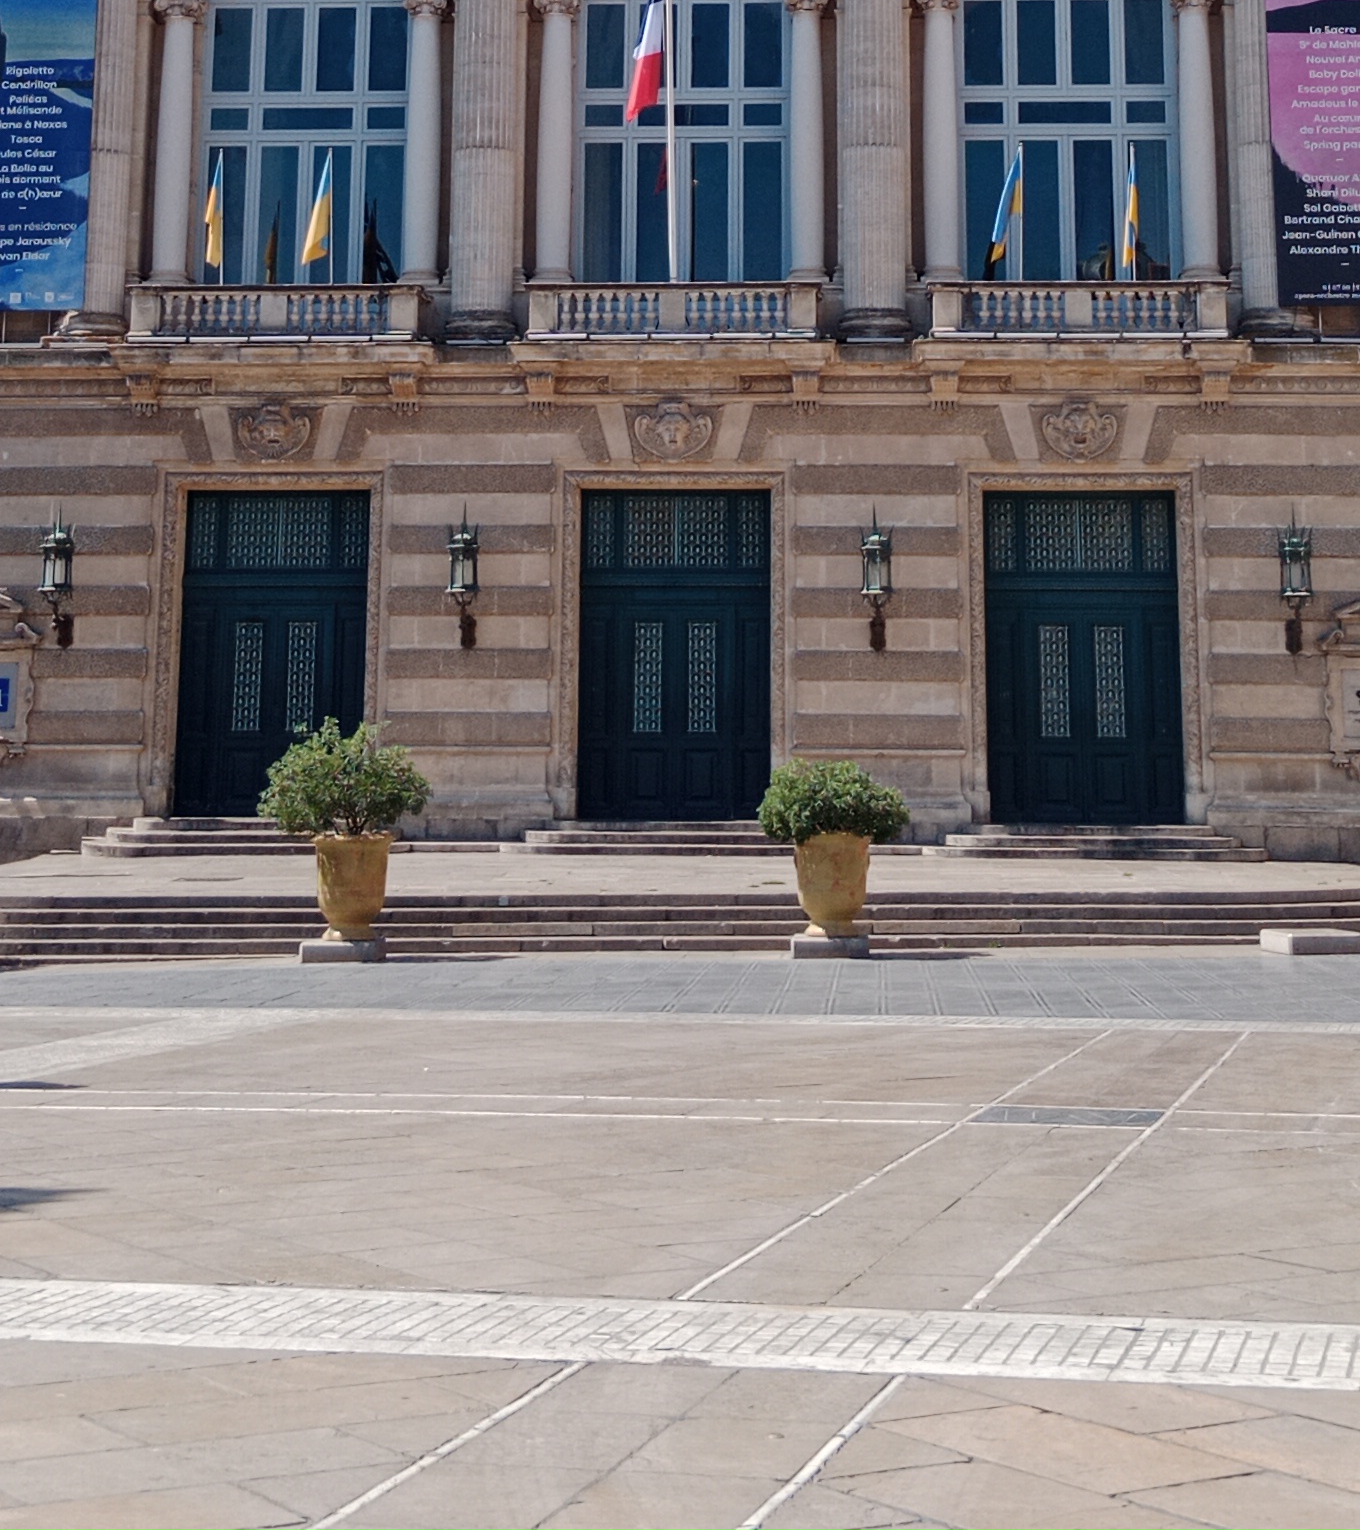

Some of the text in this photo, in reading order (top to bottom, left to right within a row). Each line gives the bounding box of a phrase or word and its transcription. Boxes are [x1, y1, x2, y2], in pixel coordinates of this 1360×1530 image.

[1324, 25, 1357, 35] Sacre
[1312, 40, 1327, 49] de
[1306, 55, 1345, 64] Nouvel
[5, 65, 54, 78] Rigoletto
[1309, 69, 1338, 81] Baby
[1, 79, 57, 89] Cendrillon
[1297, 84, 1338, 95] Escape
[1291, 98, 1346, 108] Amadeus
[1348, 98, 1359, 107] le
[6, 105, 63, 115] Mélisande
[1313, 114, 1328, 123] Au
[24, 120, 32, 129] à
[33, 120, 68, 129] Naxos
[1300, 125, 1314, 134] de
[10, 134, 43, 144] Tosca
[1303, 139, 1340, 151] Spring
[24, 148, 57, 158] César
[10, 163, 36, 173] Belle
[38, 164, 53, 172] au
[12, 175, 61, 184] dormant
[1302, 173, 1349, 183] Quatuor
[1, 189, 15, 198] de
[1306, 187, 1338, 198] Shani
[1284, 215, 1335, 224] Bertrand
[24, 221, 77, 231] résidence
[16, 236, 71, 249] Jaroussky
[1289, 244, 1348, 254] Alexandre
